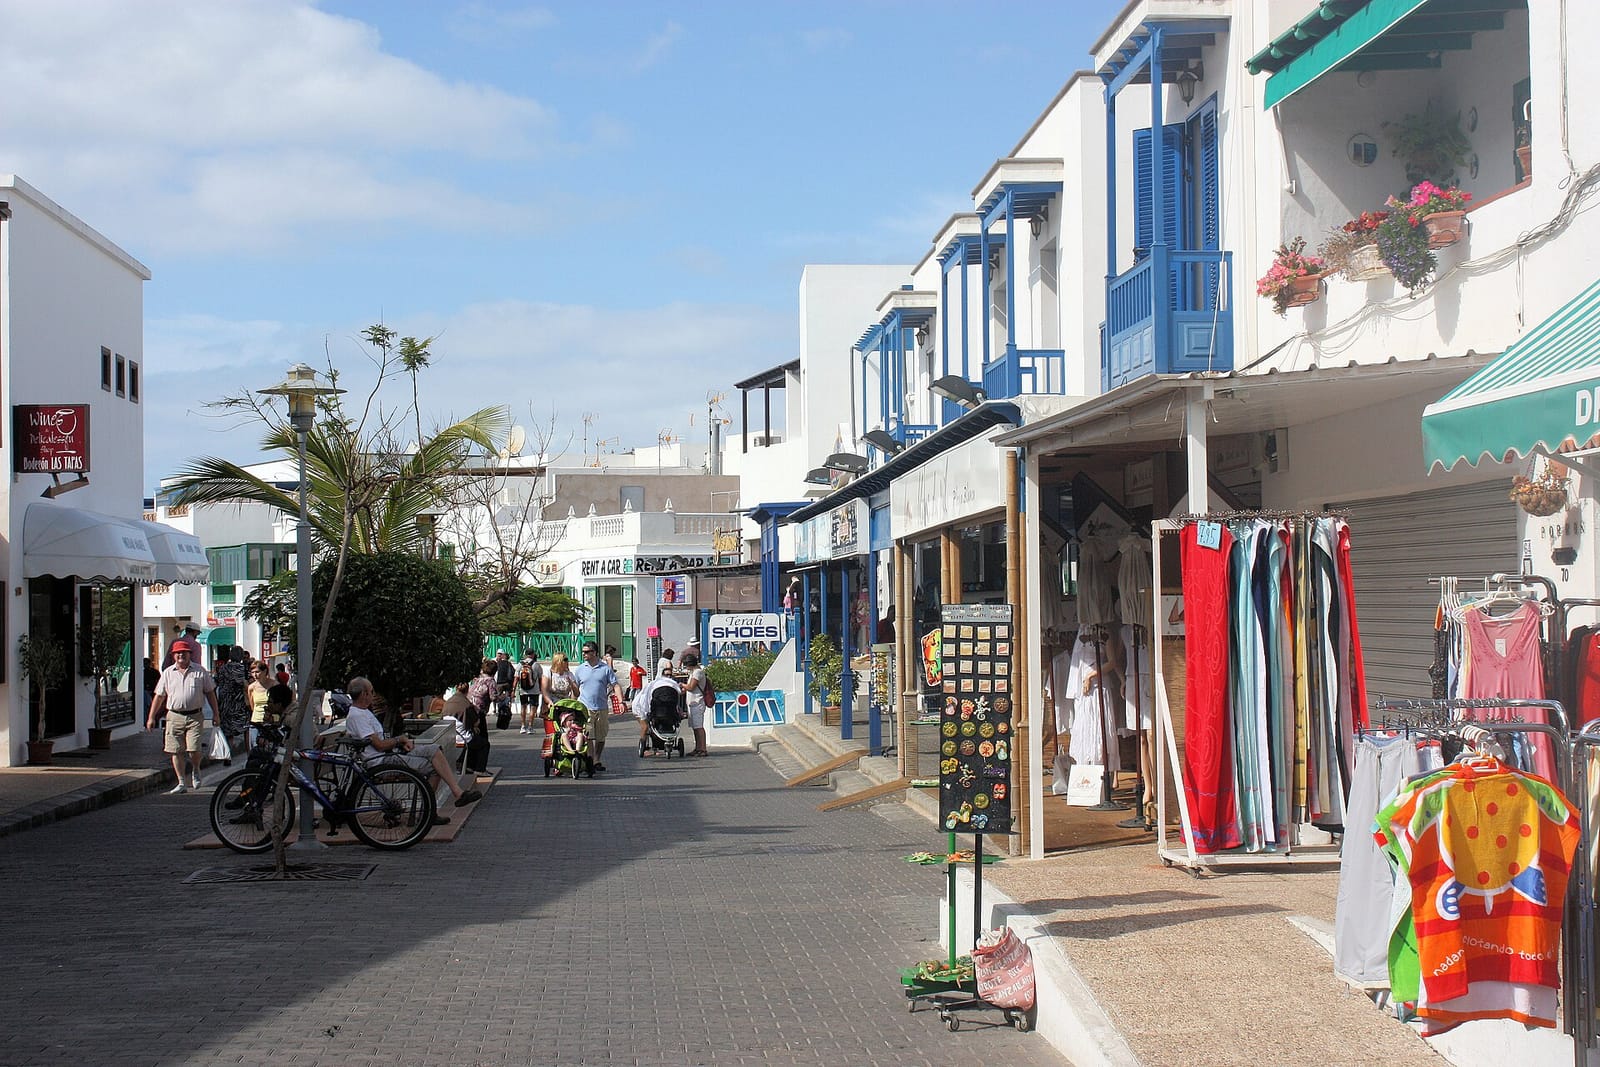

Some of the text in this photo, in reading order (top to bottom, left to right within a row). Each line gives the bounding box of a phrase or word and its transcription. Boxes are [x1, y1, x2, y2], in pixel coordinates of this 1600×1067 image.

[30, 411, 63, 426] Wines
[51, 457, 62, 470] LAS
[64, 456, 83, 470] TAPAS
[582, 559, 621, 576] RENT A CAR
[1561, 568, 1569, 582] 70
[726, 615, 764, 626] Terali
[712, 626, 778, 639] SHOES
